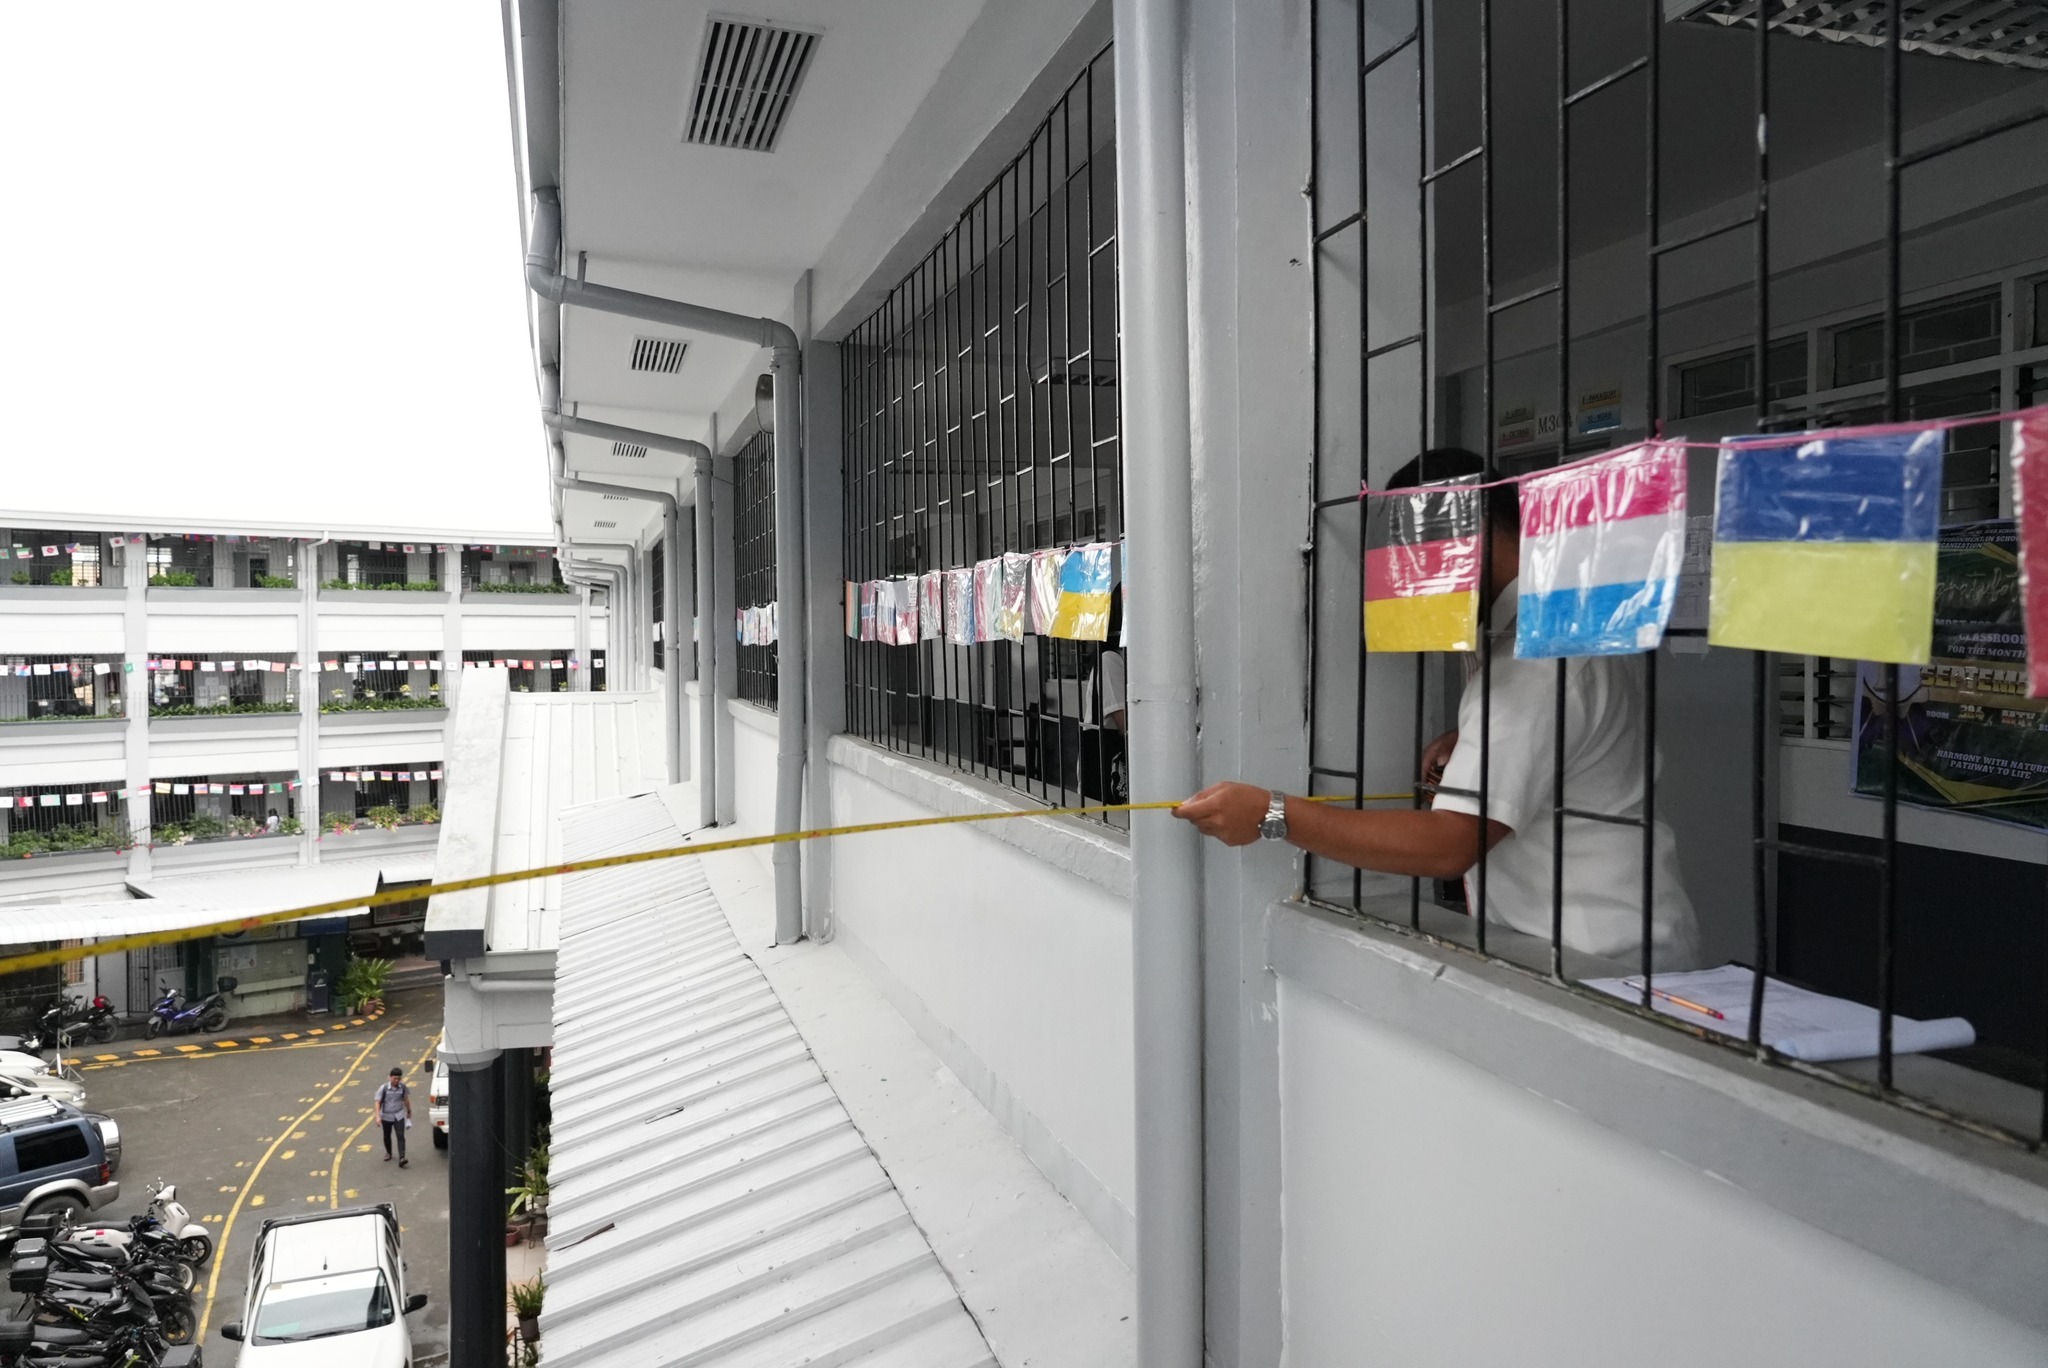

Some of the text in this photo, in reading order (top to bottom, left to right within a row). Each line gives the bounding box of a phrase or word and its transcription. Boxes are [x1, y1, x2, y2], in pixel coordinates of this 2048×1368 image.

[1947, 645, 2026, 659] FOR THE MONTH
[1920, 665, 2028, 696] SEPTEMB
[1926, 710, 1949, 719] ROOM
[1937, 750, 2048, 773] HARMONY WITH NATURE
[1950, 760, 2032, 779] PATHWAY TO LIFE
